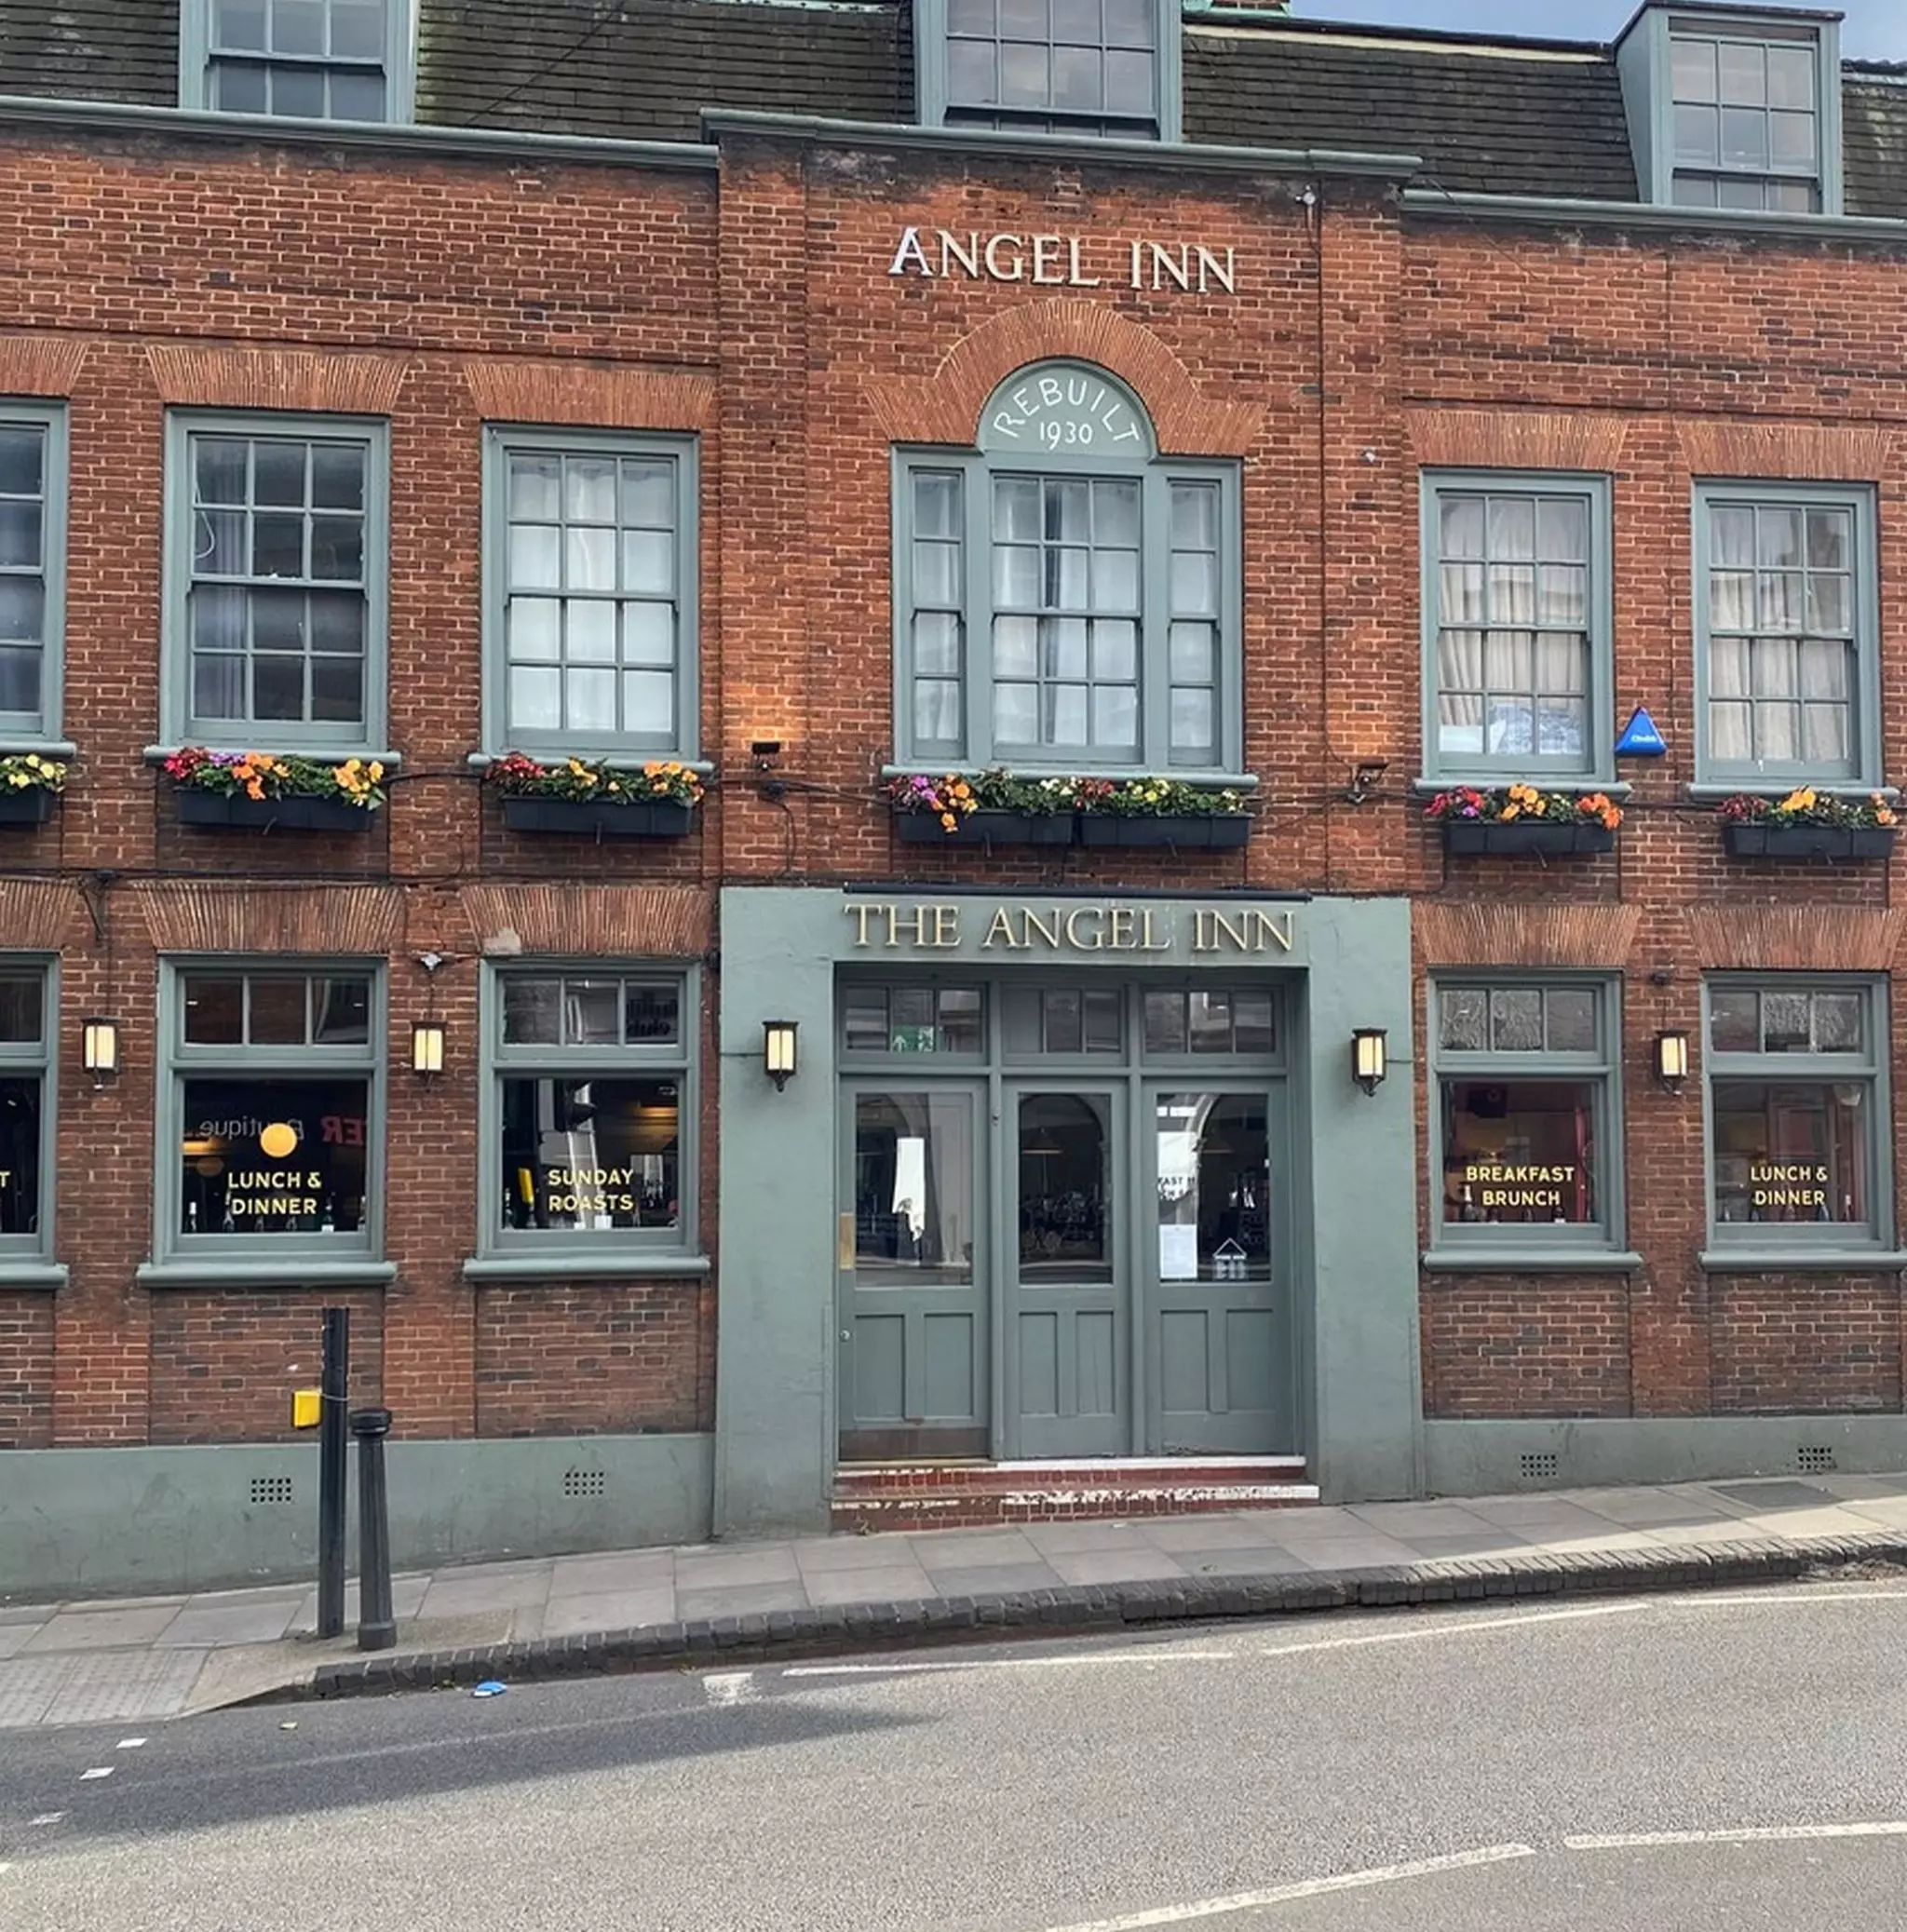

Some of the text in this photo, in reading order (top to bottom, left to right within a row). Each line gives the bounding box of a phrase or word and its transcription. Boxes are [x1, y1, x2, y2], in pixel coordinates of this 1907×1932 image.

[887, 226, 1237, 294] ANGEL INN
[994, 377, 1140, 443] REBUILT
[1039, 421, 1093, 451] 1930
[845, 903, 1295, 953] THE ANGEL INN
[228, 1171, 322, 1189] LUNCH &
[548, 1169, 633, 1186] SUNDAY
[1466, 1166, 1576, 1182] BREAKFAST
[1751, 1166, 1829, 1182] LUNCH &
[232, 1197, 318, 1215] DINNER
[548, 1195, 633, 1211] ROASTS
[1482, 1190, 1561, 1207] BRUNCH
[1753, 1190, 1826, 1207] DINNER
